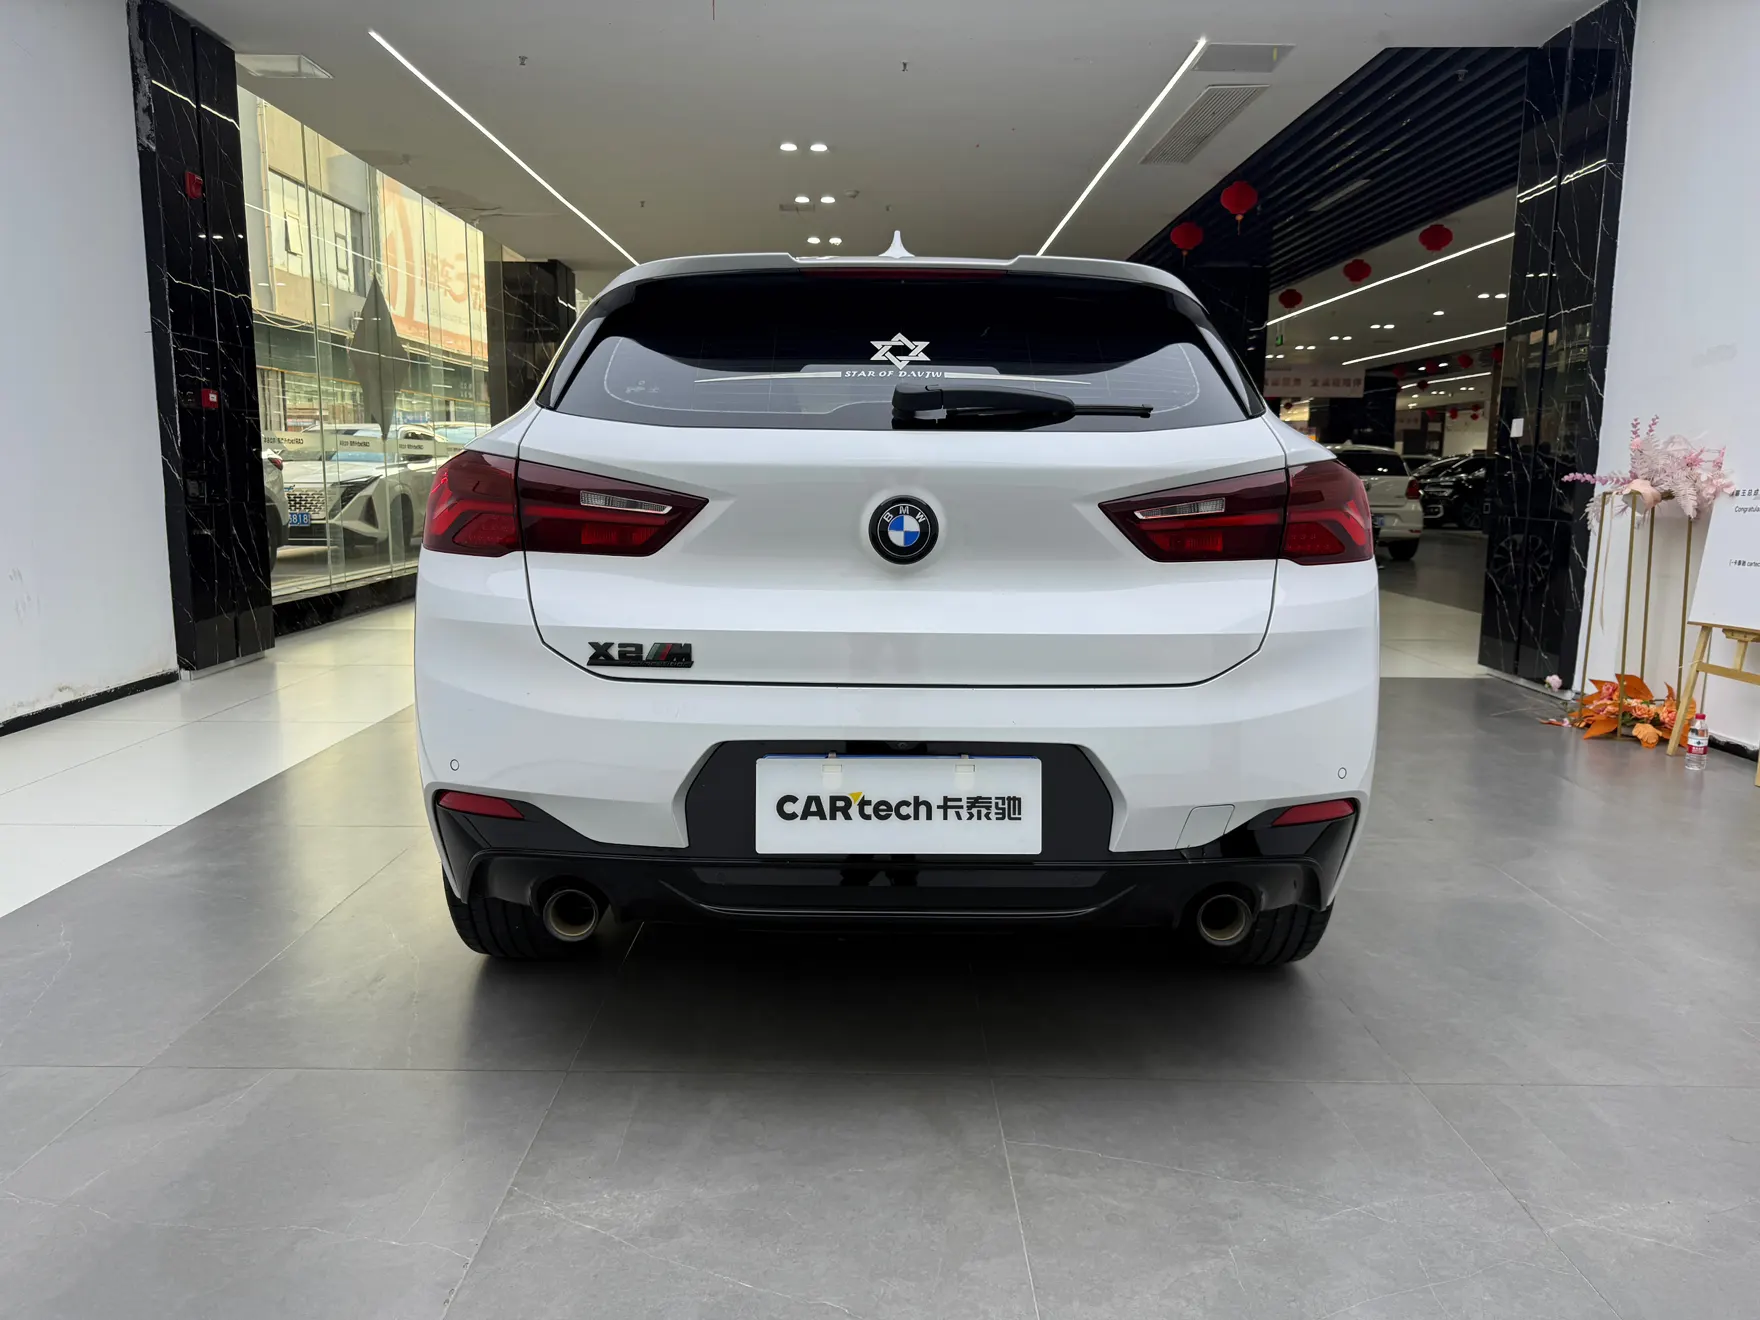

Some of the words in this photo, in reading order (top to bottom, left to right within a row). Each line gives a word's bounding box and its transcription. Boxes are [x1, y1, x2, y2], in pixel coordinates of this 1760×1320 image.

[844, 370, 876, 378] STAR
[883, 506, 926, 523] BMW
[588, 641, 644, 661] X2
[776, 793, 933, 821] CARtech
[936, 795, 1022, 821] 卡泰驰
